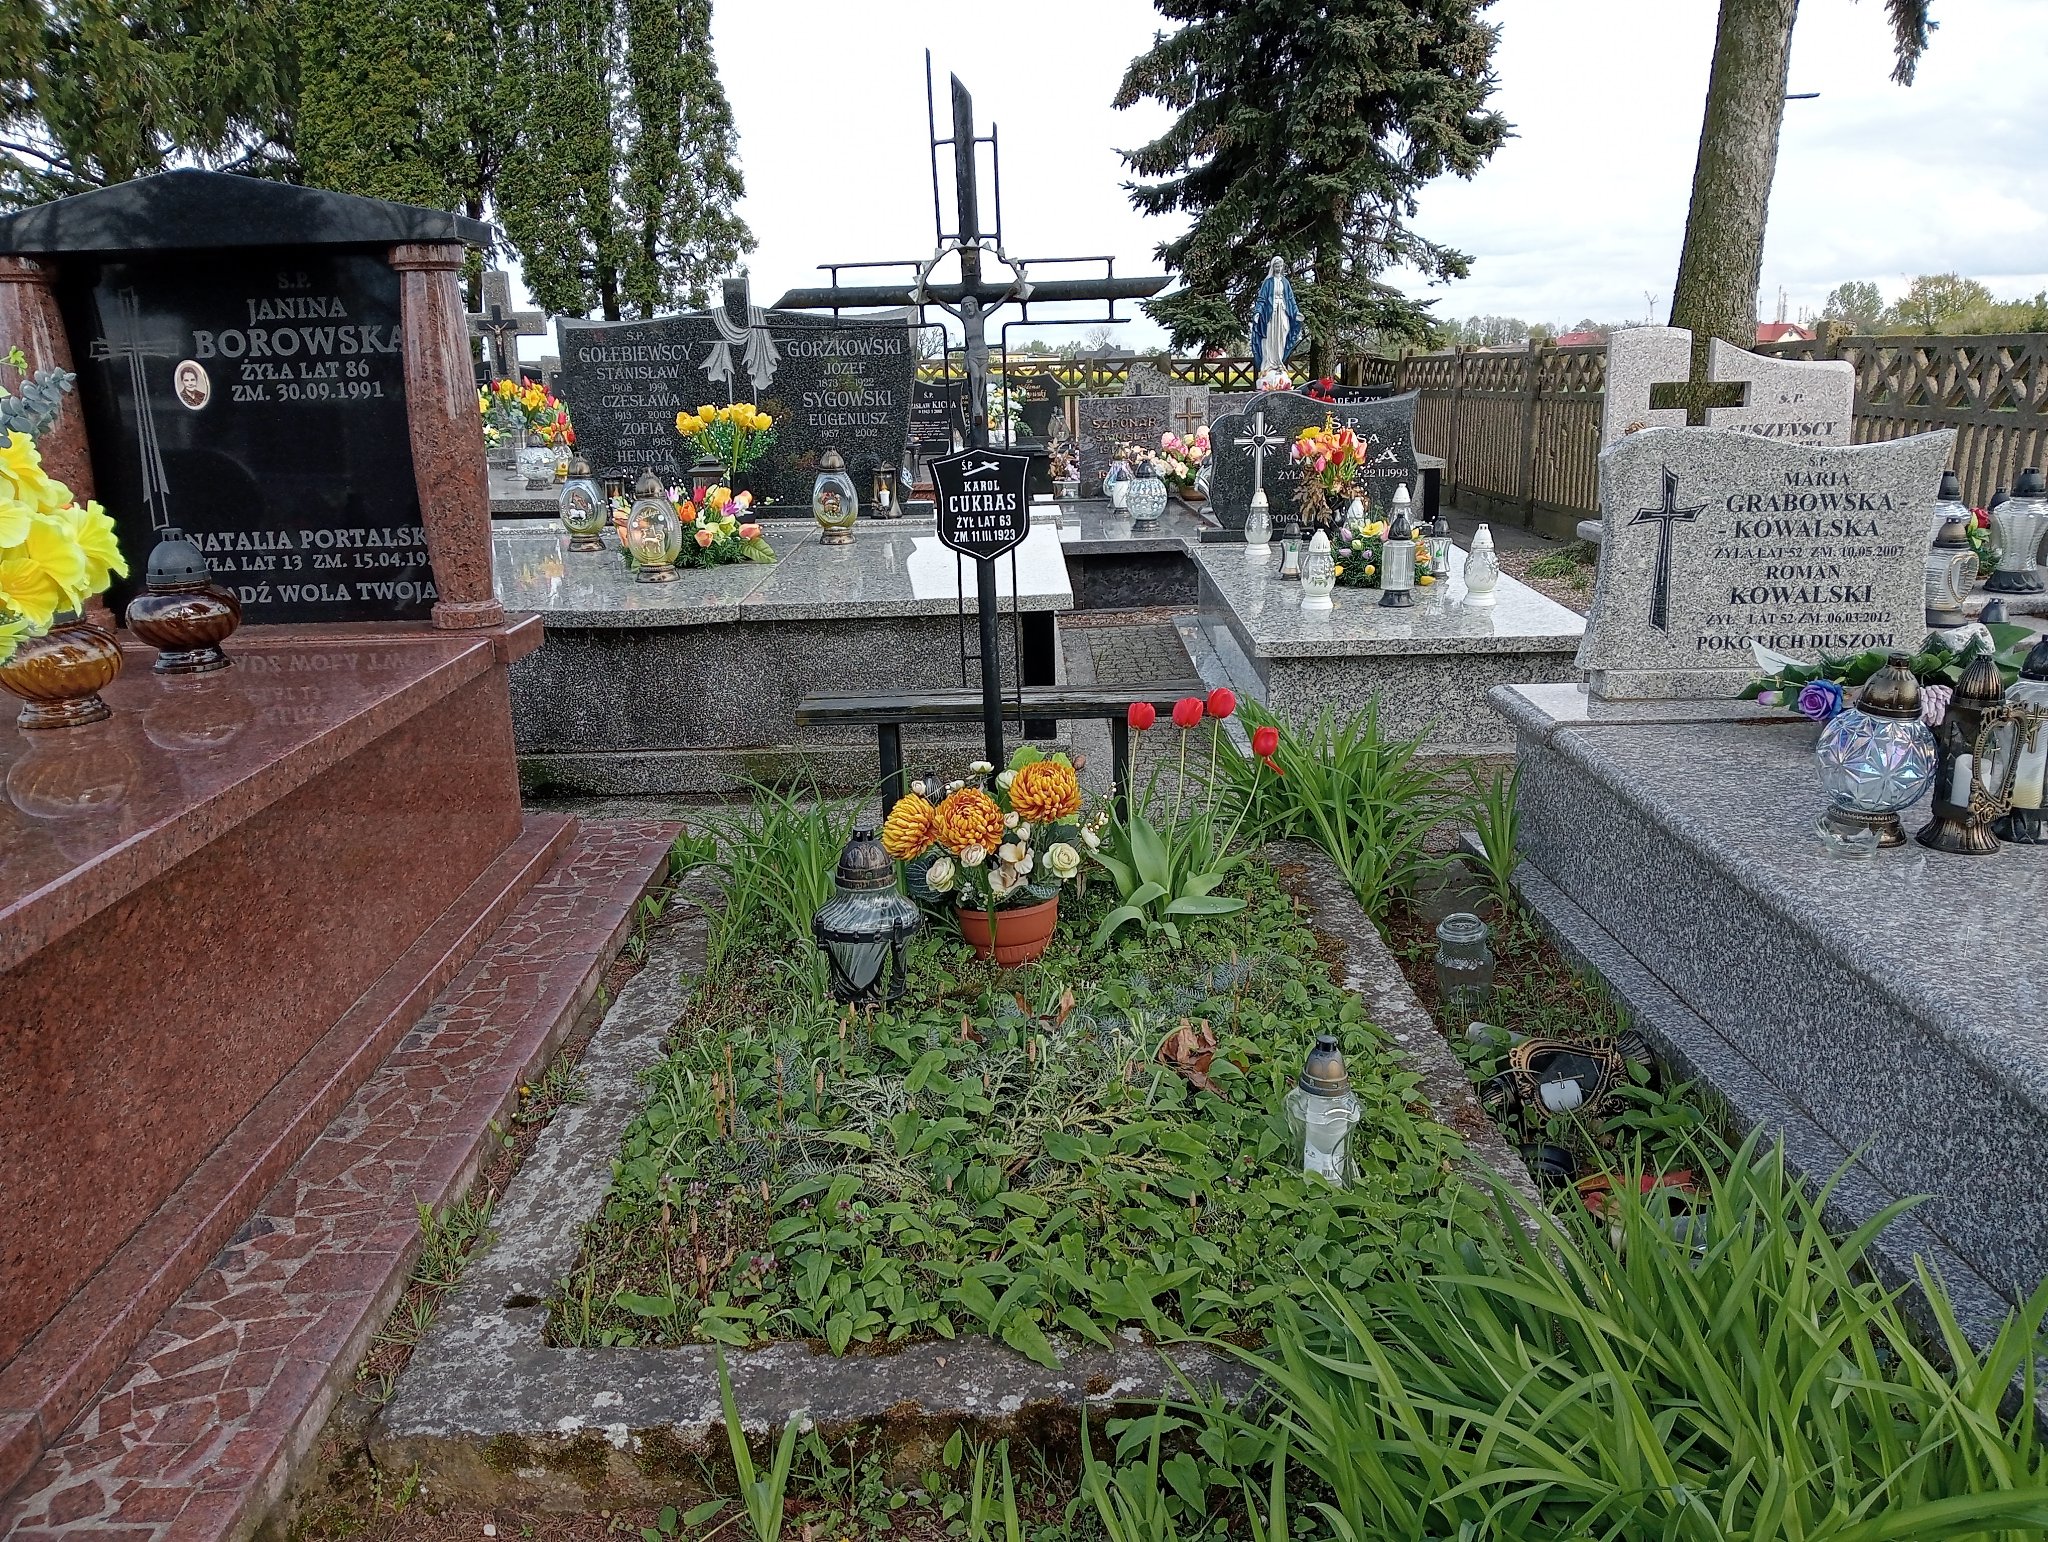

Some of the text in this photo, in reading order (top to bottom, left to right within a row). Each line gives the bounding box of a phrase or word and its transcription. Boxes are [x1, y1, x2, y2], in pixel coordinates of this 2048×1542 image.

[247, 297, 347, 326] JANINA
[193, 325, 403, 358] BOROWSKA
[787, 337, 902, 357] GORZKOWSKI
[241, 359, 370, 381] ŻYŁA LAT 86
[596, 364, 680, 380] STANISŁAW
[855, 378, 875, 388] 1922
[232, 381, 384, 402] ZM. 30.09.1991
[802, 388, 892, 407] SYGOWSKI
[602, 393, 681, 408] CZESŁAWA
[808, 412, 888, 426] EUGENIUSZ
[622, 422, 665, 435] ZOFIA
[855, 428, 878, 437] 2002
[617, 448, 674, 462] HENRYK
[1363, 469, 1376, 477] 22
[1783, 472, 1851, 486] MARIA
[964, 480, 1000, 492] KAROL
[949, 493, 1016, 513] CUKRAS
[1726, 492, 1895, 512] GRABOWSKA
[956, 515, 1012, 528] ŻYŁ LAT 63
[1735, 518, 1880, 538] KOWALSKA
[184, 527, 428, 551] NATALIA PORTALSK
[954, 530, 970, 542] ZM.
[203, 555, 237, 572] YŁA
[241, 555, 277, 571] LAT
[283, 554, 303, 570] 13
[313, 553, 348, 569] ZM.
[1766, 565, 1842, 580] ROMAN
[277, 583, 352, 602] WOLA
[356, 581, 439, 604] TWOJA
[1730, 585, 1874, 605] KOWALSKI
[1749, 612, 1776, 625] LAT
[1780, 613, 1794, 624] 52
[1769, 634, 1804, 649] ICH
[1811, 633, 1895, 648] DUSZOM
